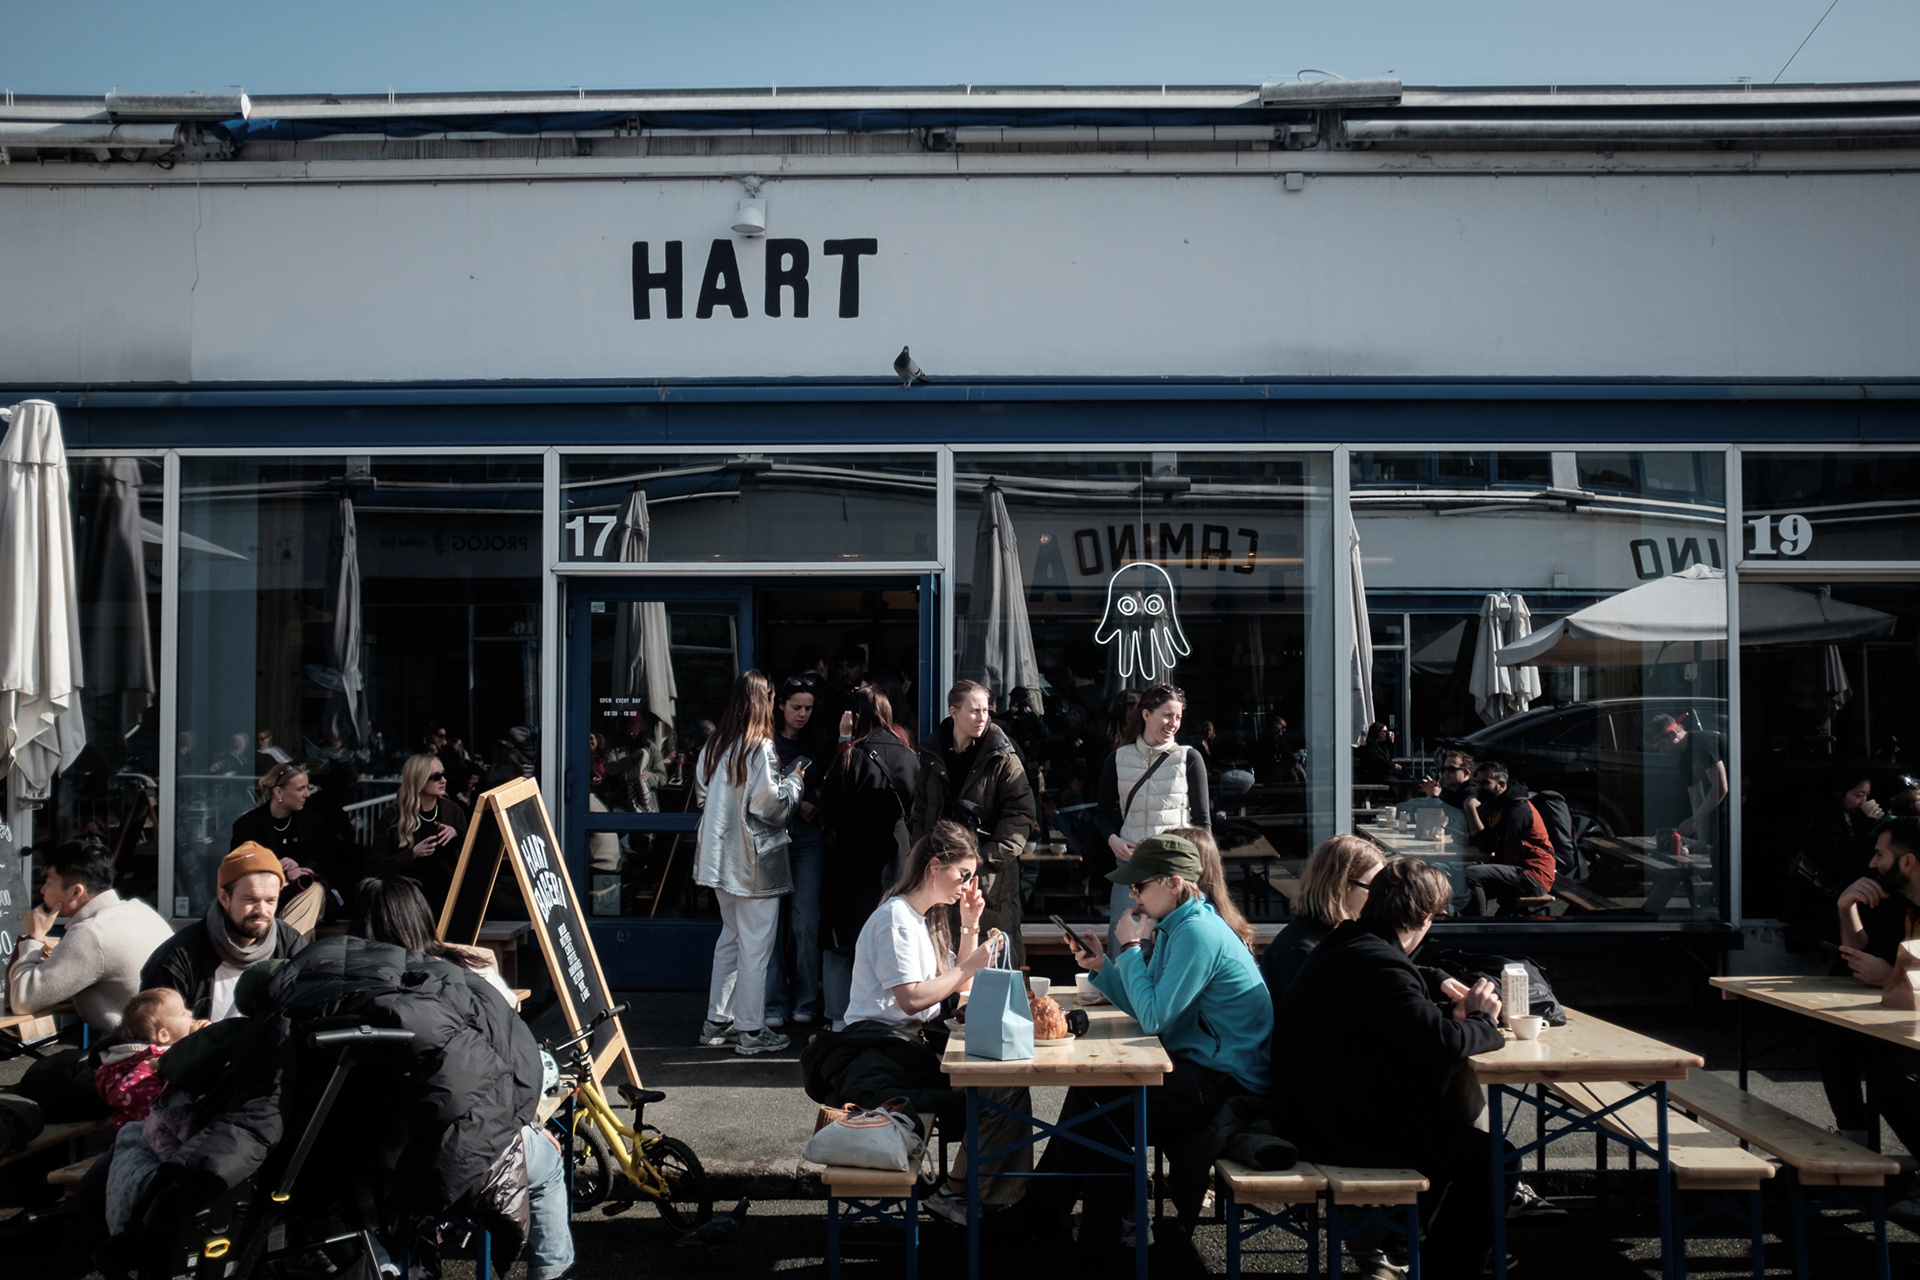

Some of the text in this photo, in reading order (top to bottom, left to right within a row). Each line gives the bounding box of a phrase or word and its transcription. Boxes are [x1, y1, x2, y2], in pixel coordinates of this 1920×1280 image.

[632, 238, 878, 320] HART
[565, 516, 617, 557] 17
[1748, 514, 1813, 556] 19
[521, 834, 549, 879] HART
[534, 871, 567, 923] BAGERI
